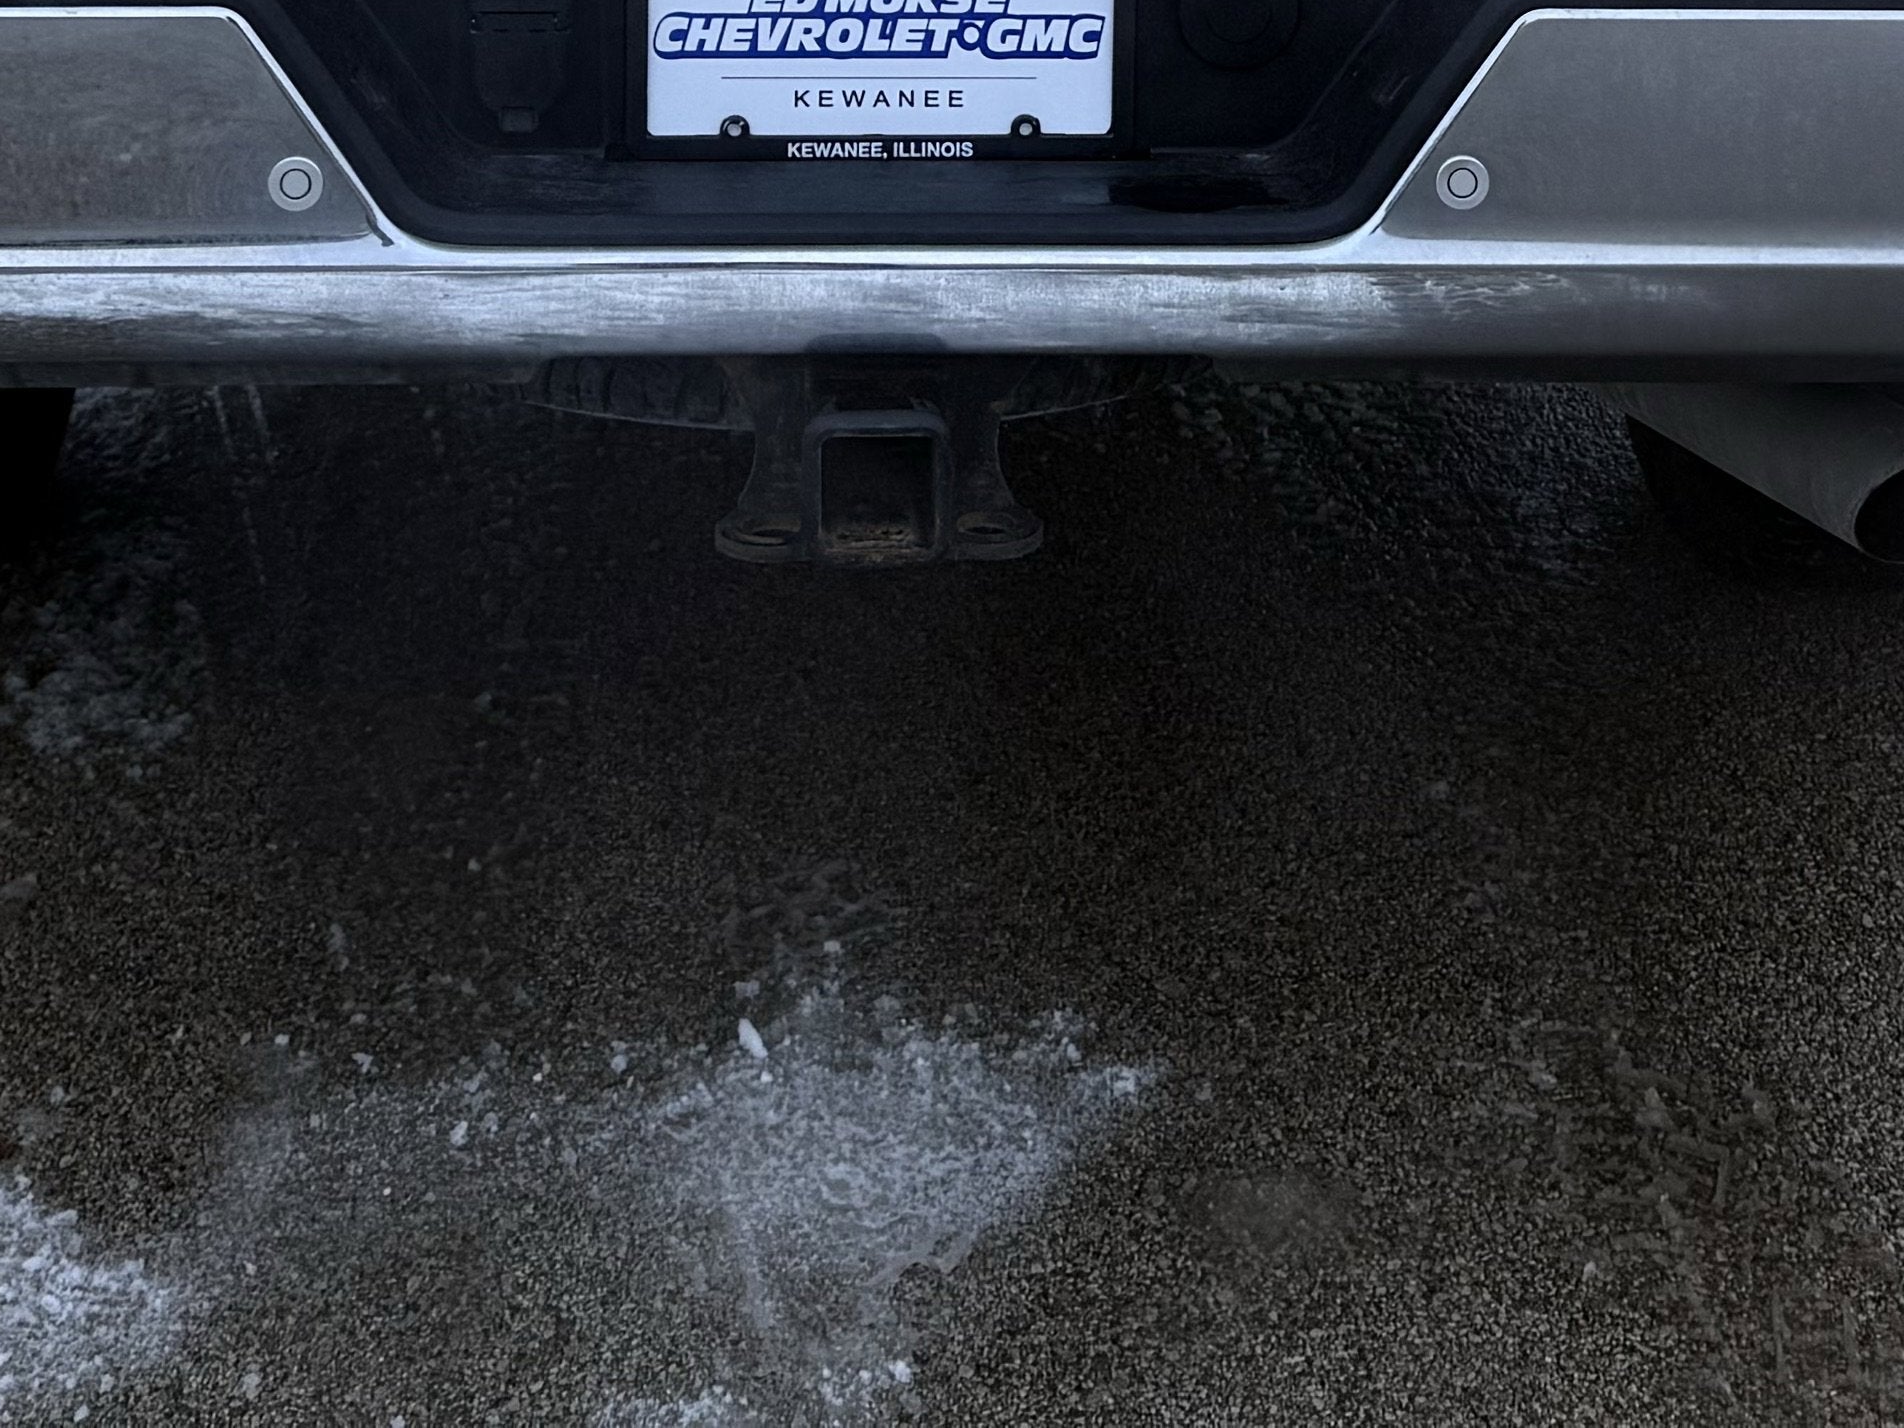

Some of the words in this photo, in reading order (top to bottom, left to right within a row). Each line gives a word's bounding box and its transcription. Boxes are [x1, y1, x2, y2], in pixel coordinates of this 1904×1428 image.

[794, 89, 964, 108] KEWANEE
[787, 142, 888, 160] KEWANEE,
[893, 142, 974, 158] ILLINOIS
